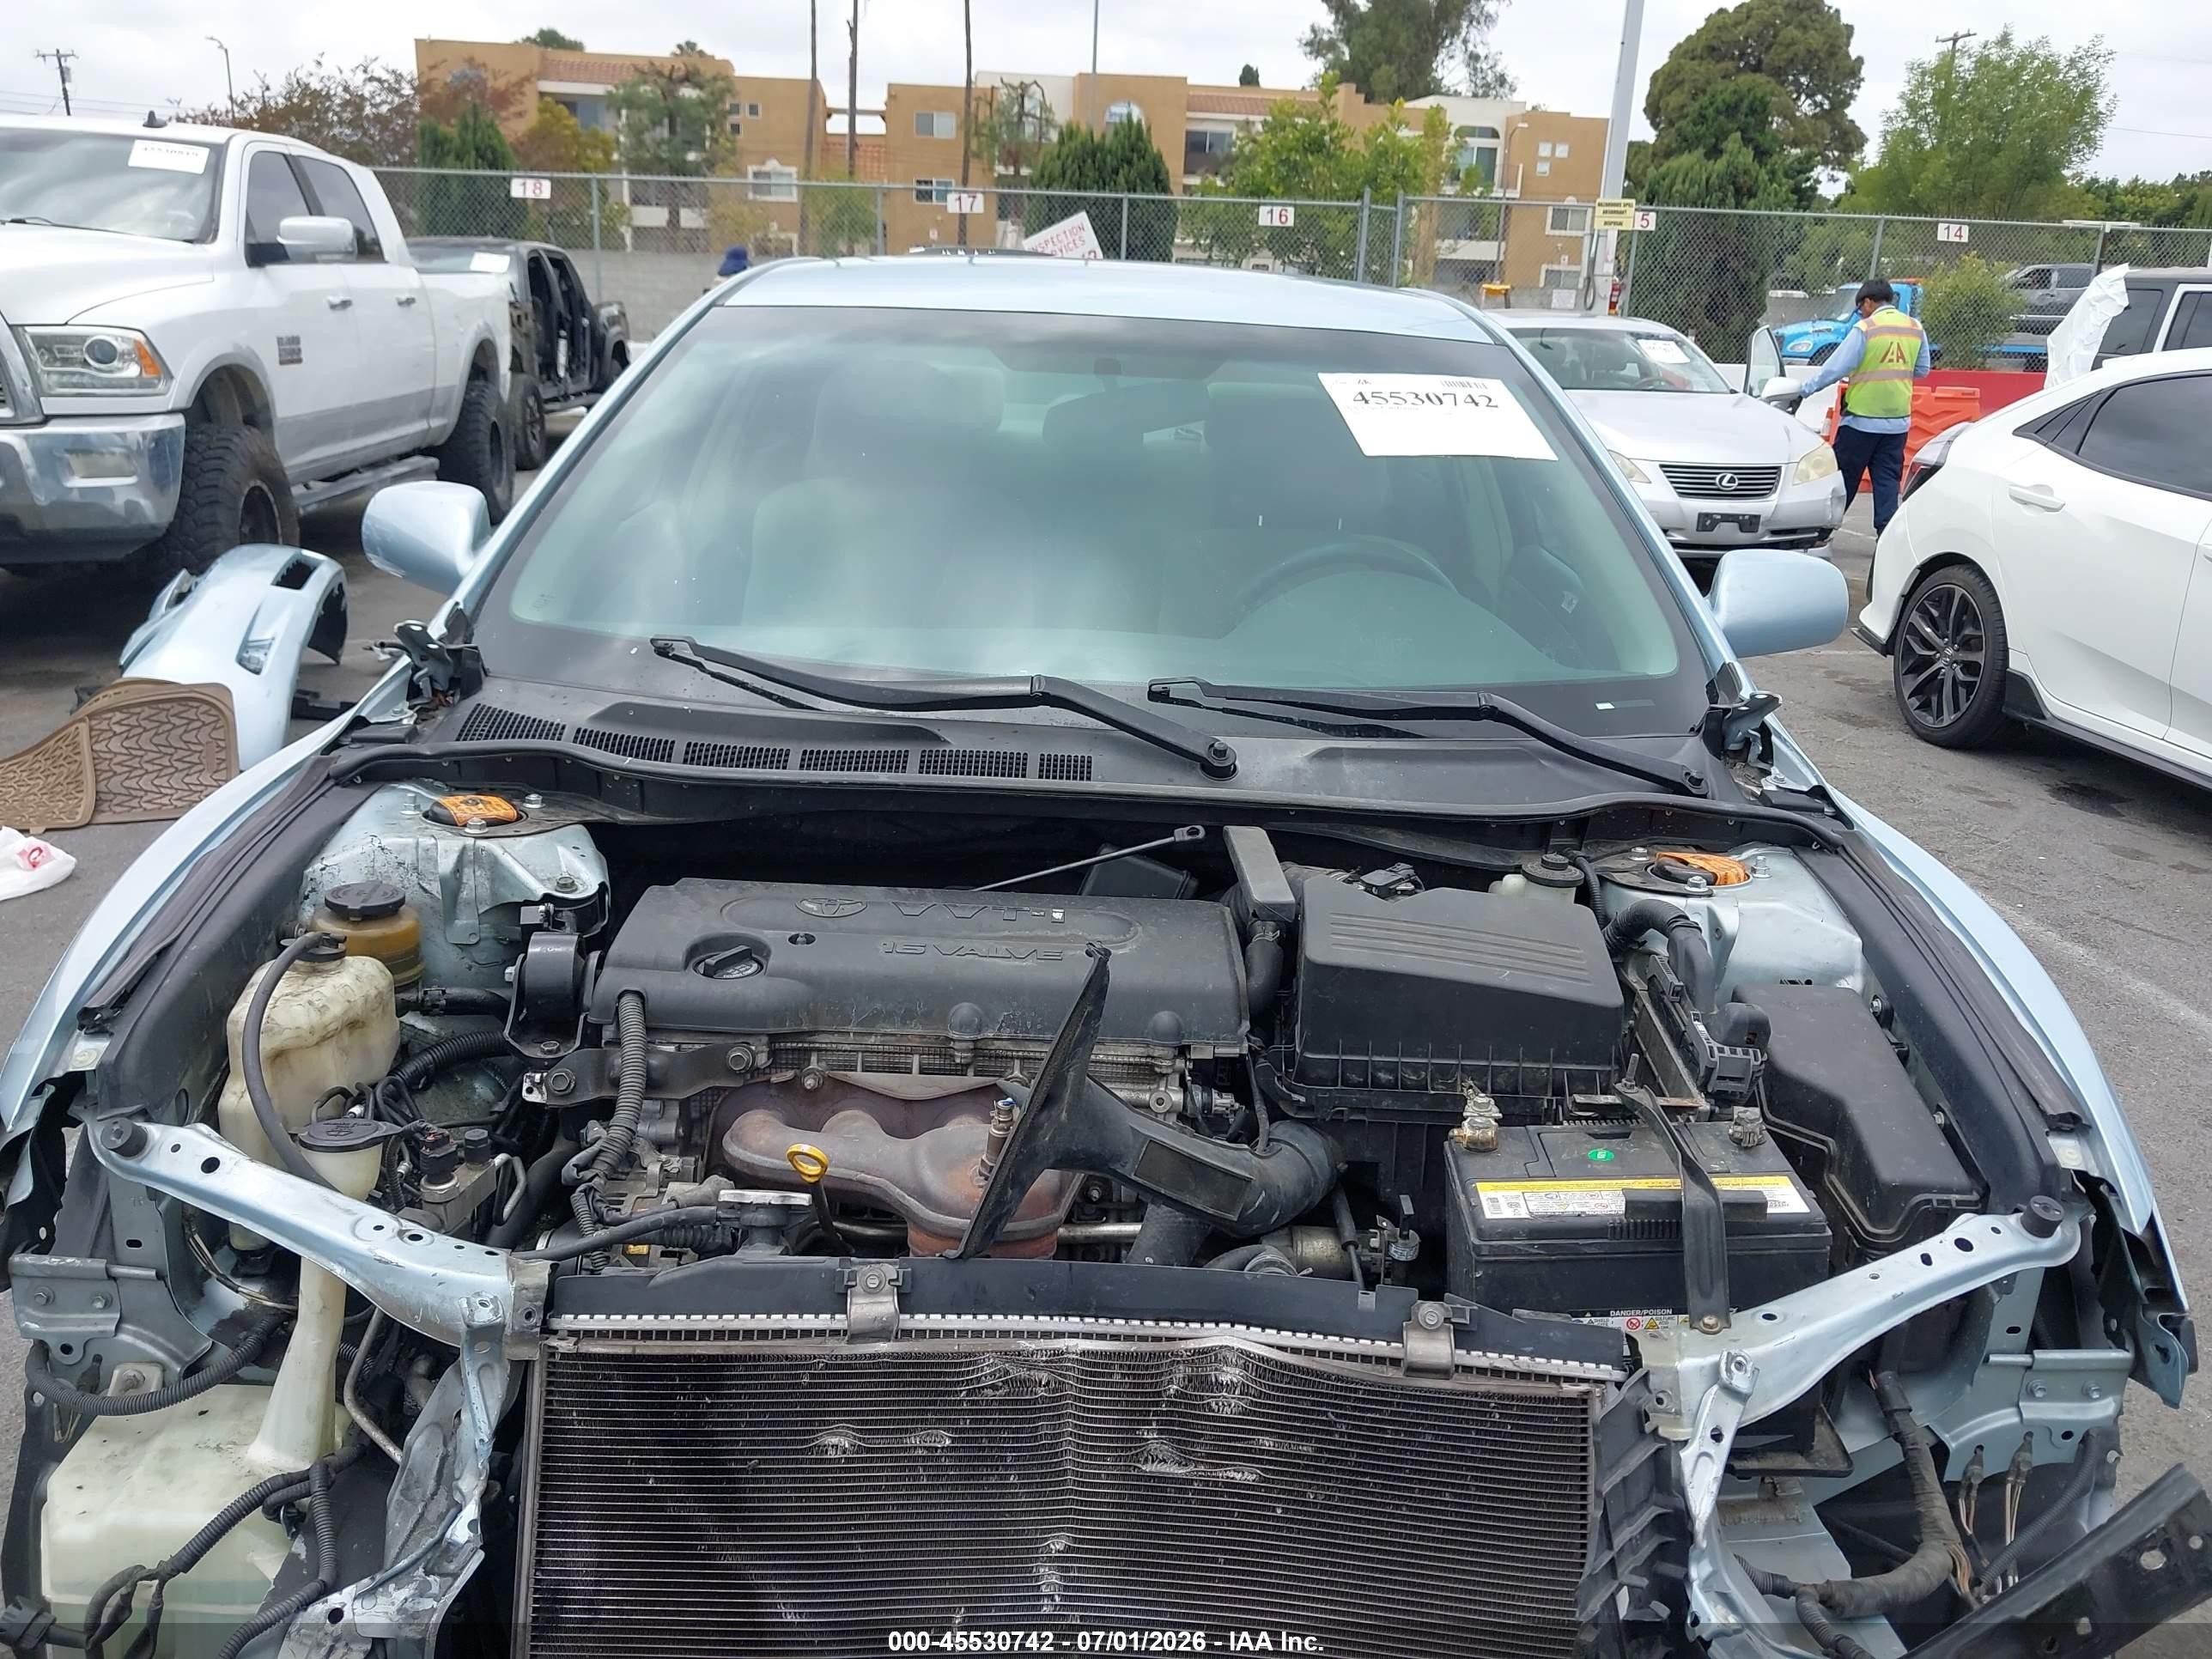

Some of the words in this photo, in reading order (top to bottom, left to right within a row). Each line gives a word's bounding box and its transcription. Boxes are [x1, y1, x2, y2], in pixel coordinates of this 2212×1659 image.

[520, 179, 543, 197] 18
[955, 193, 977, 212] 17
[1267, 208, 1289, 225] 16
[1640, 213, 1650, 228] 5
[1944, 224, 1964, 240] 14
[1352, 391, 1498, 408] 45530742
[880, 940, 927, 955] 16
[933, 944, 1063, 961] VALVE
[1609, 1308, 1673, 1317] DANGER/POISON
